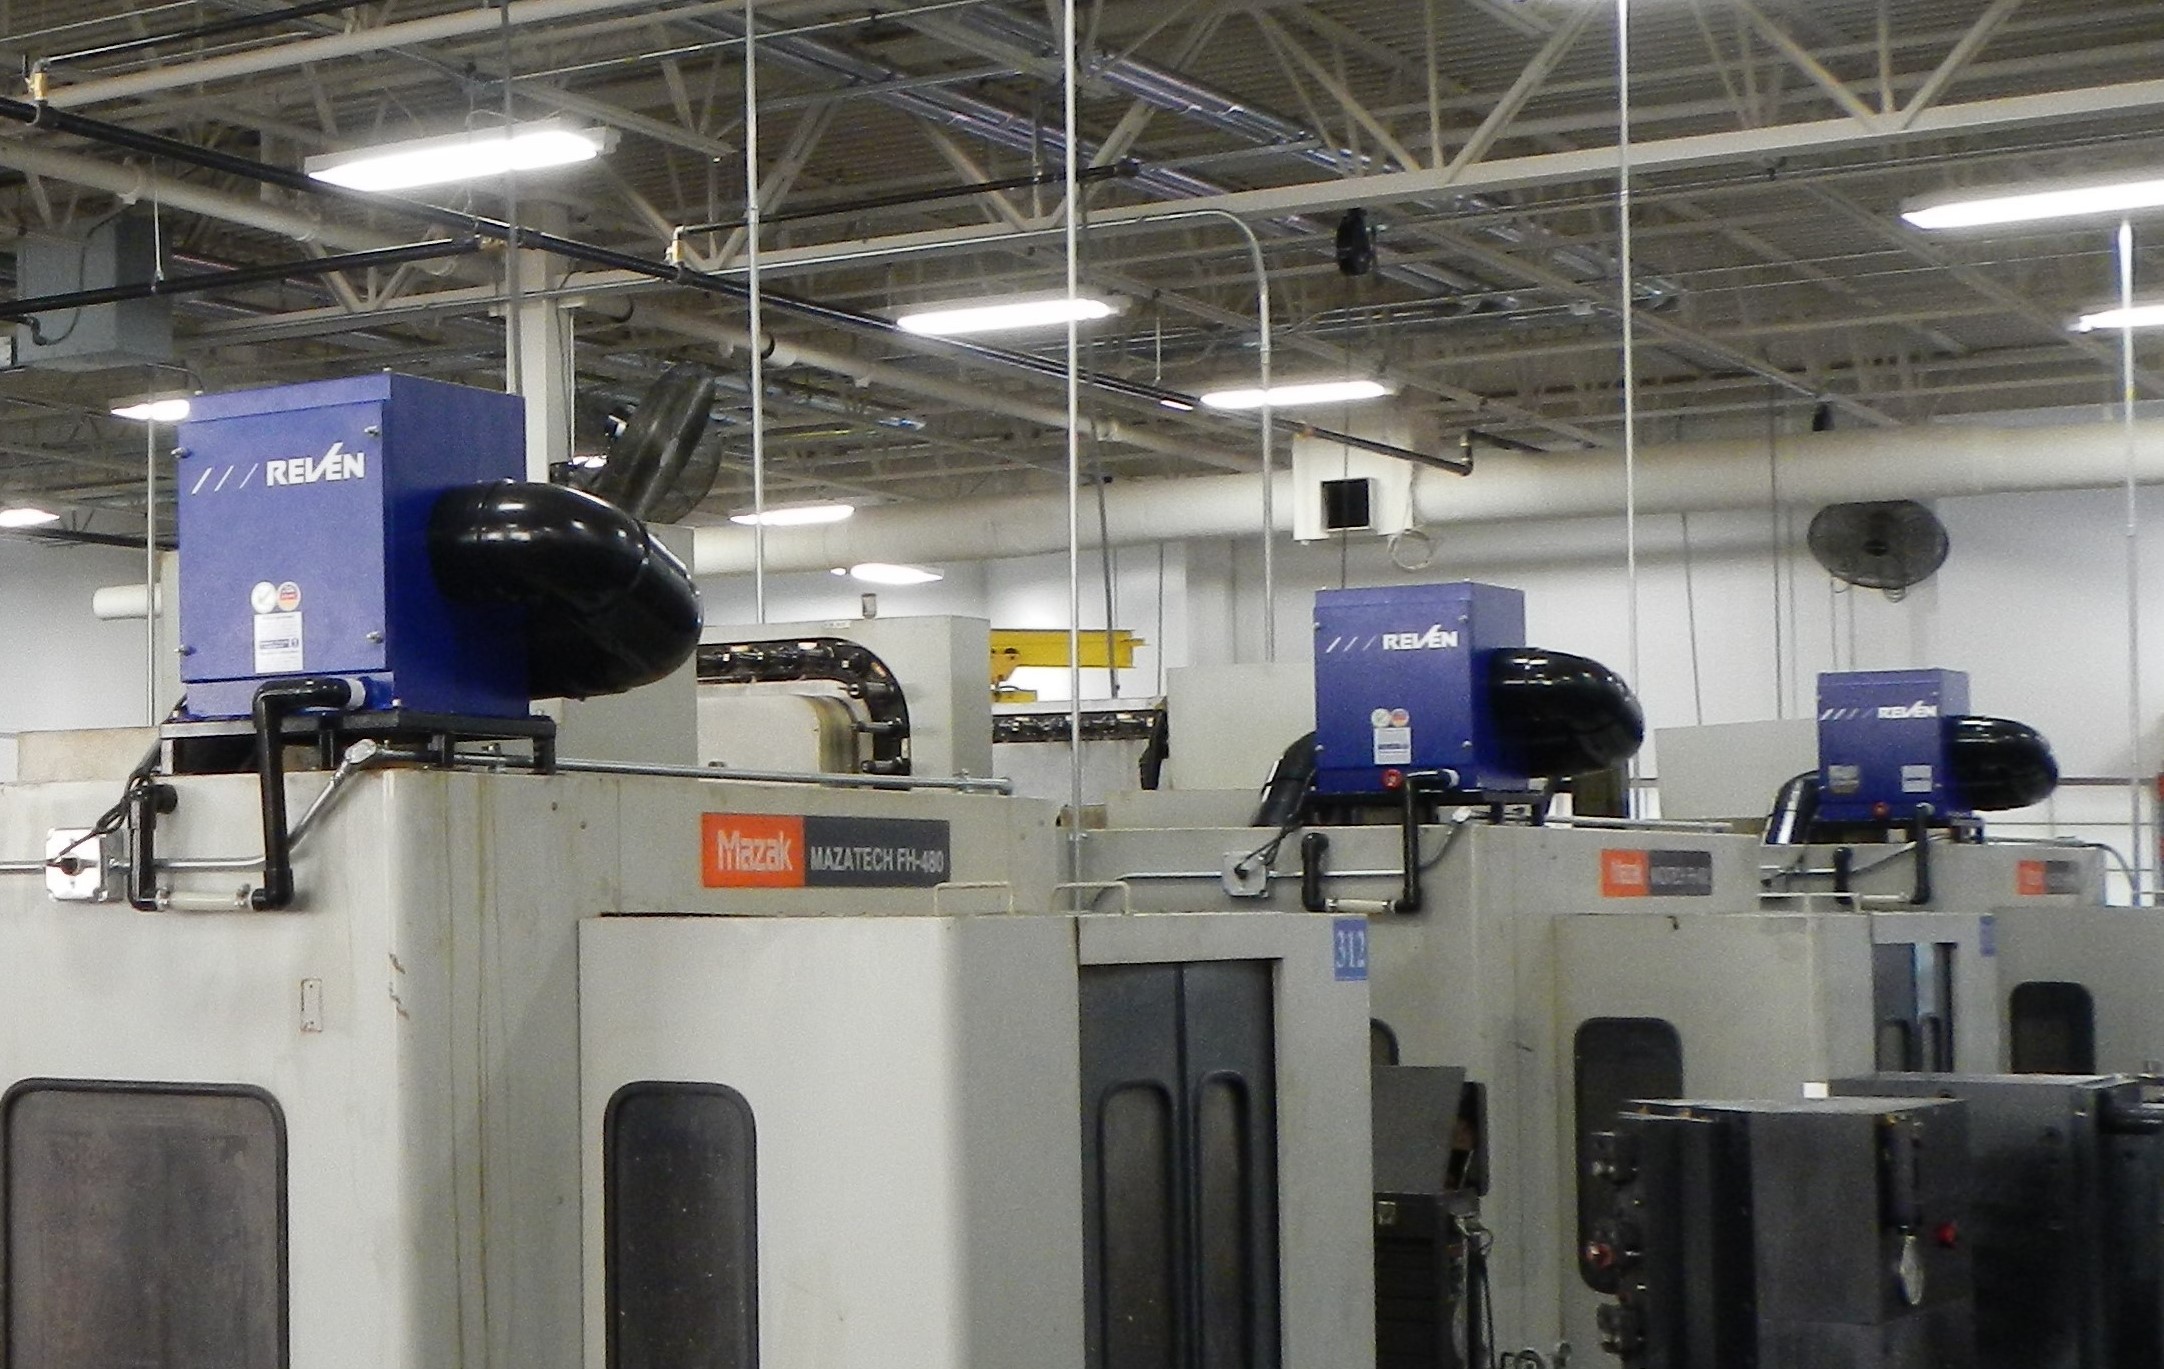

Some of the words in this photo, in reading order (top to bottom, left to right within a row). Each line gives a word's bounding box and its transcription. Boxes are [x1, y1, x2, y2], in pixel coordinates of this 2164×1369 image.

[266, 442, 365, 486] REVEN
[1382, 624, 1459, 650] REVEN
[716, 829, 793, 872] Mazak
[810, 845, 893, 871] MAZATECH
